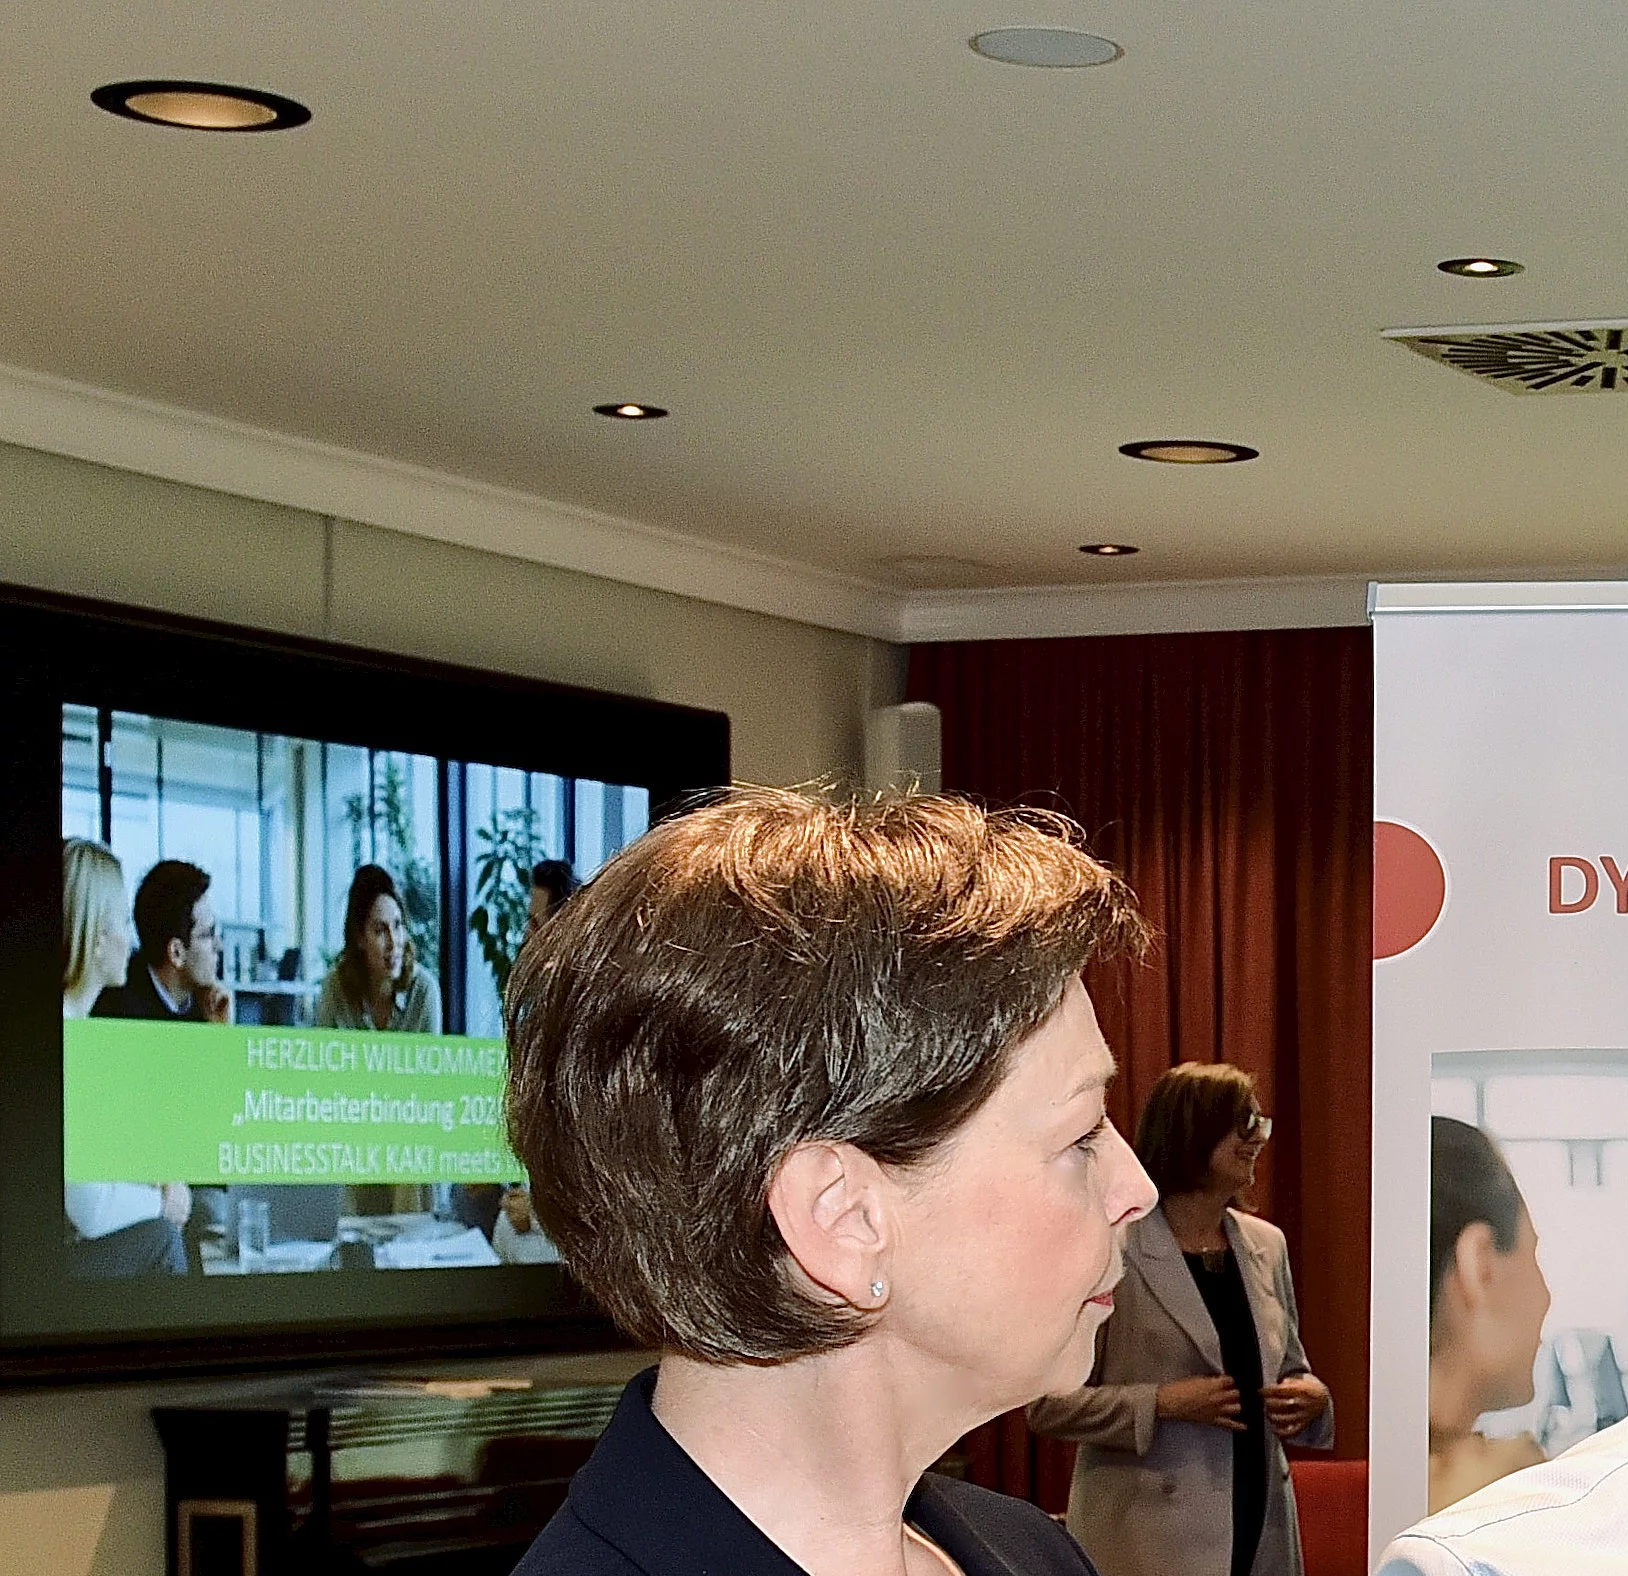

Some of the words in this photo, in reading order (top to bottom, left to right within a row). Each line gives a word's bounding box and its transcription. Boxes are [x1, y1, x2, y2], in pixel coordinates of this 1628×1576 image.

[247, 1038, 356, 1072] HERZLICH
[460, 1095, 501, 1125] 202
[218, 1142, 382, 1175] BUSINESSTALK
